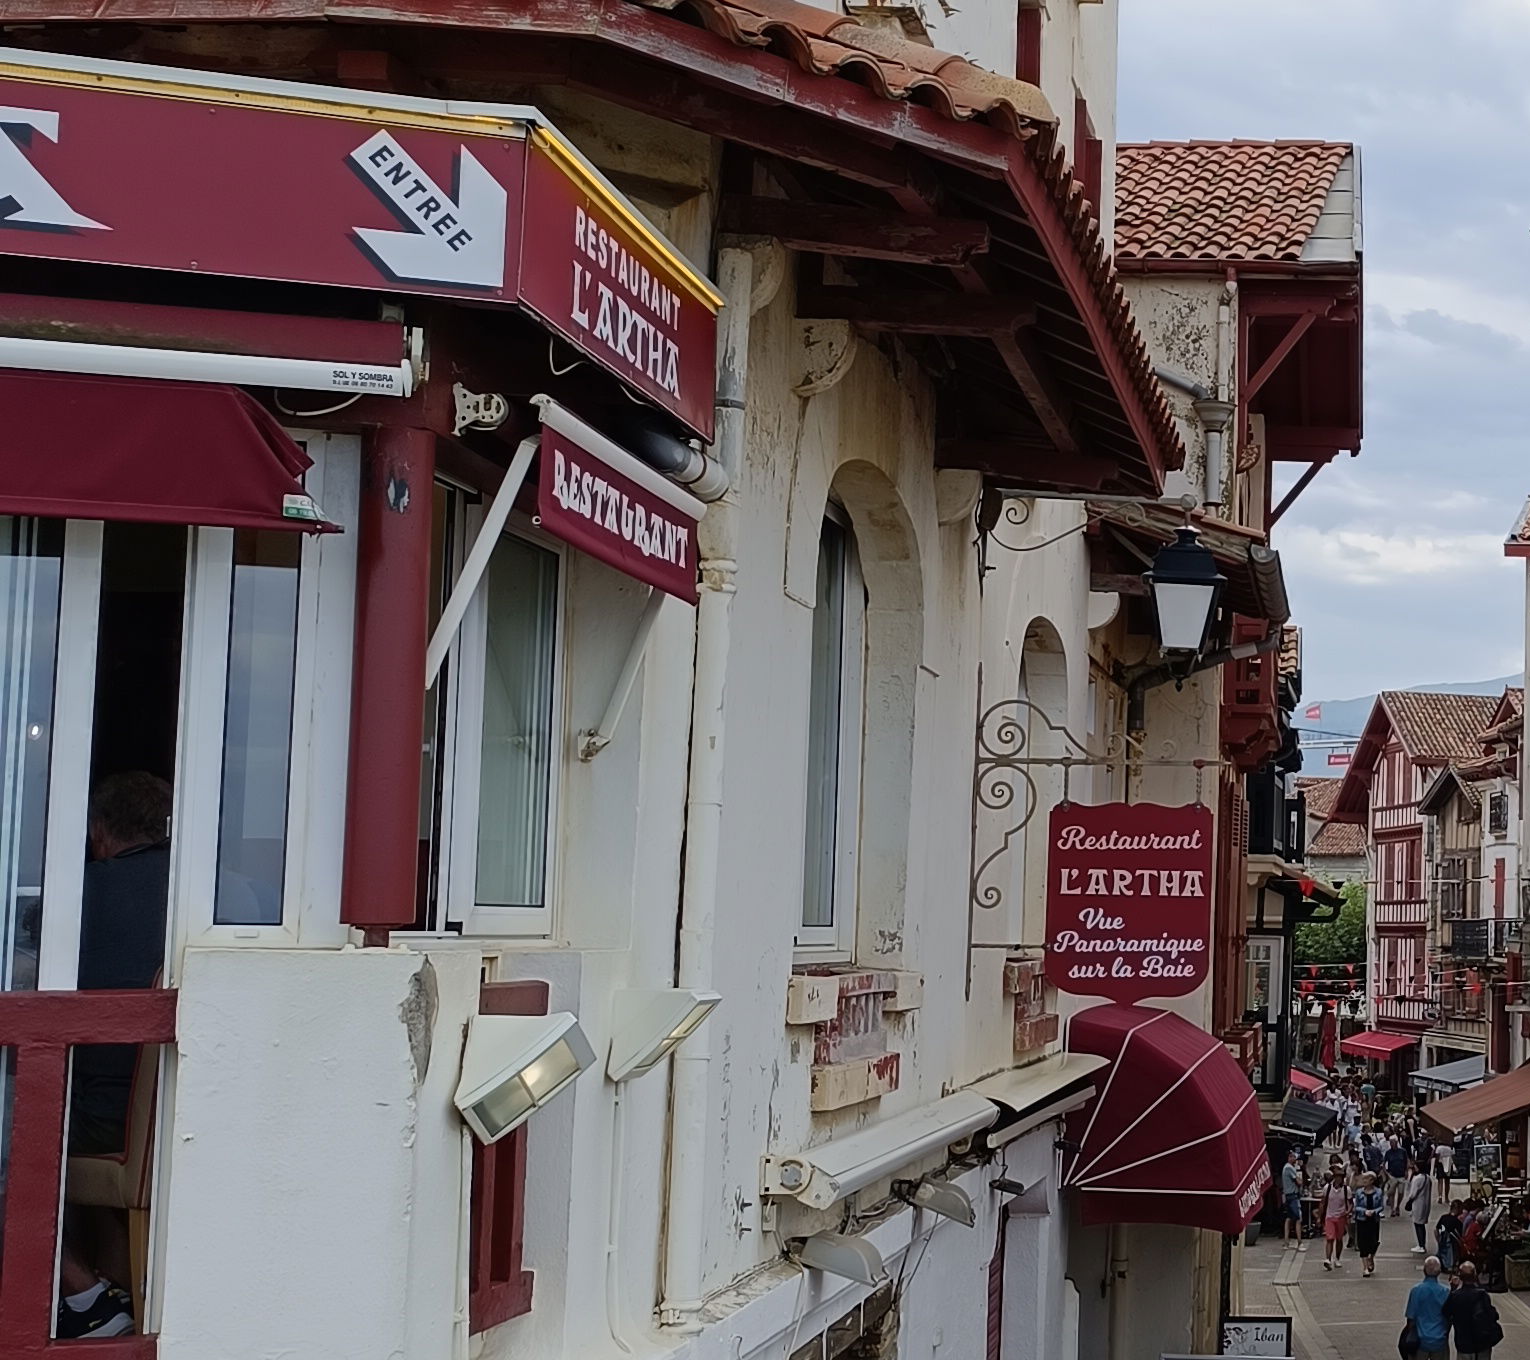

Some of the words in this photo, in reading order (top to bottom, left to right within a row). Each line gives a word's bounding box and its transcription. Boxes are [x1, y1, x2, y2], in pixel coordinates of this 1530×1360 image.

[368, 144, 472, 253] ENTREE
[574, 205, 681, 332] RESTAURANT
[571, 259, 682, 401] L'ARTHA
[333, 371, 349, 379] SOL
[358, 372, 394, 382] SOMBRA
[553, 449, 688, 568] RESTAURANT
[1057, 826, 1202, 850] Restaurant
[1060, 868, 1205, 897] L'ARTHA
[1078, 907, 1125, 930] Vue
[1053, 930, 1205, 960] Panoramique
[1068, 961, 1107, 978] sur
[1111, 957, 1135, 978] la
[1139, 956, 1196, 978] Baie
[1254, 1327, 1284, 1342] Iban
